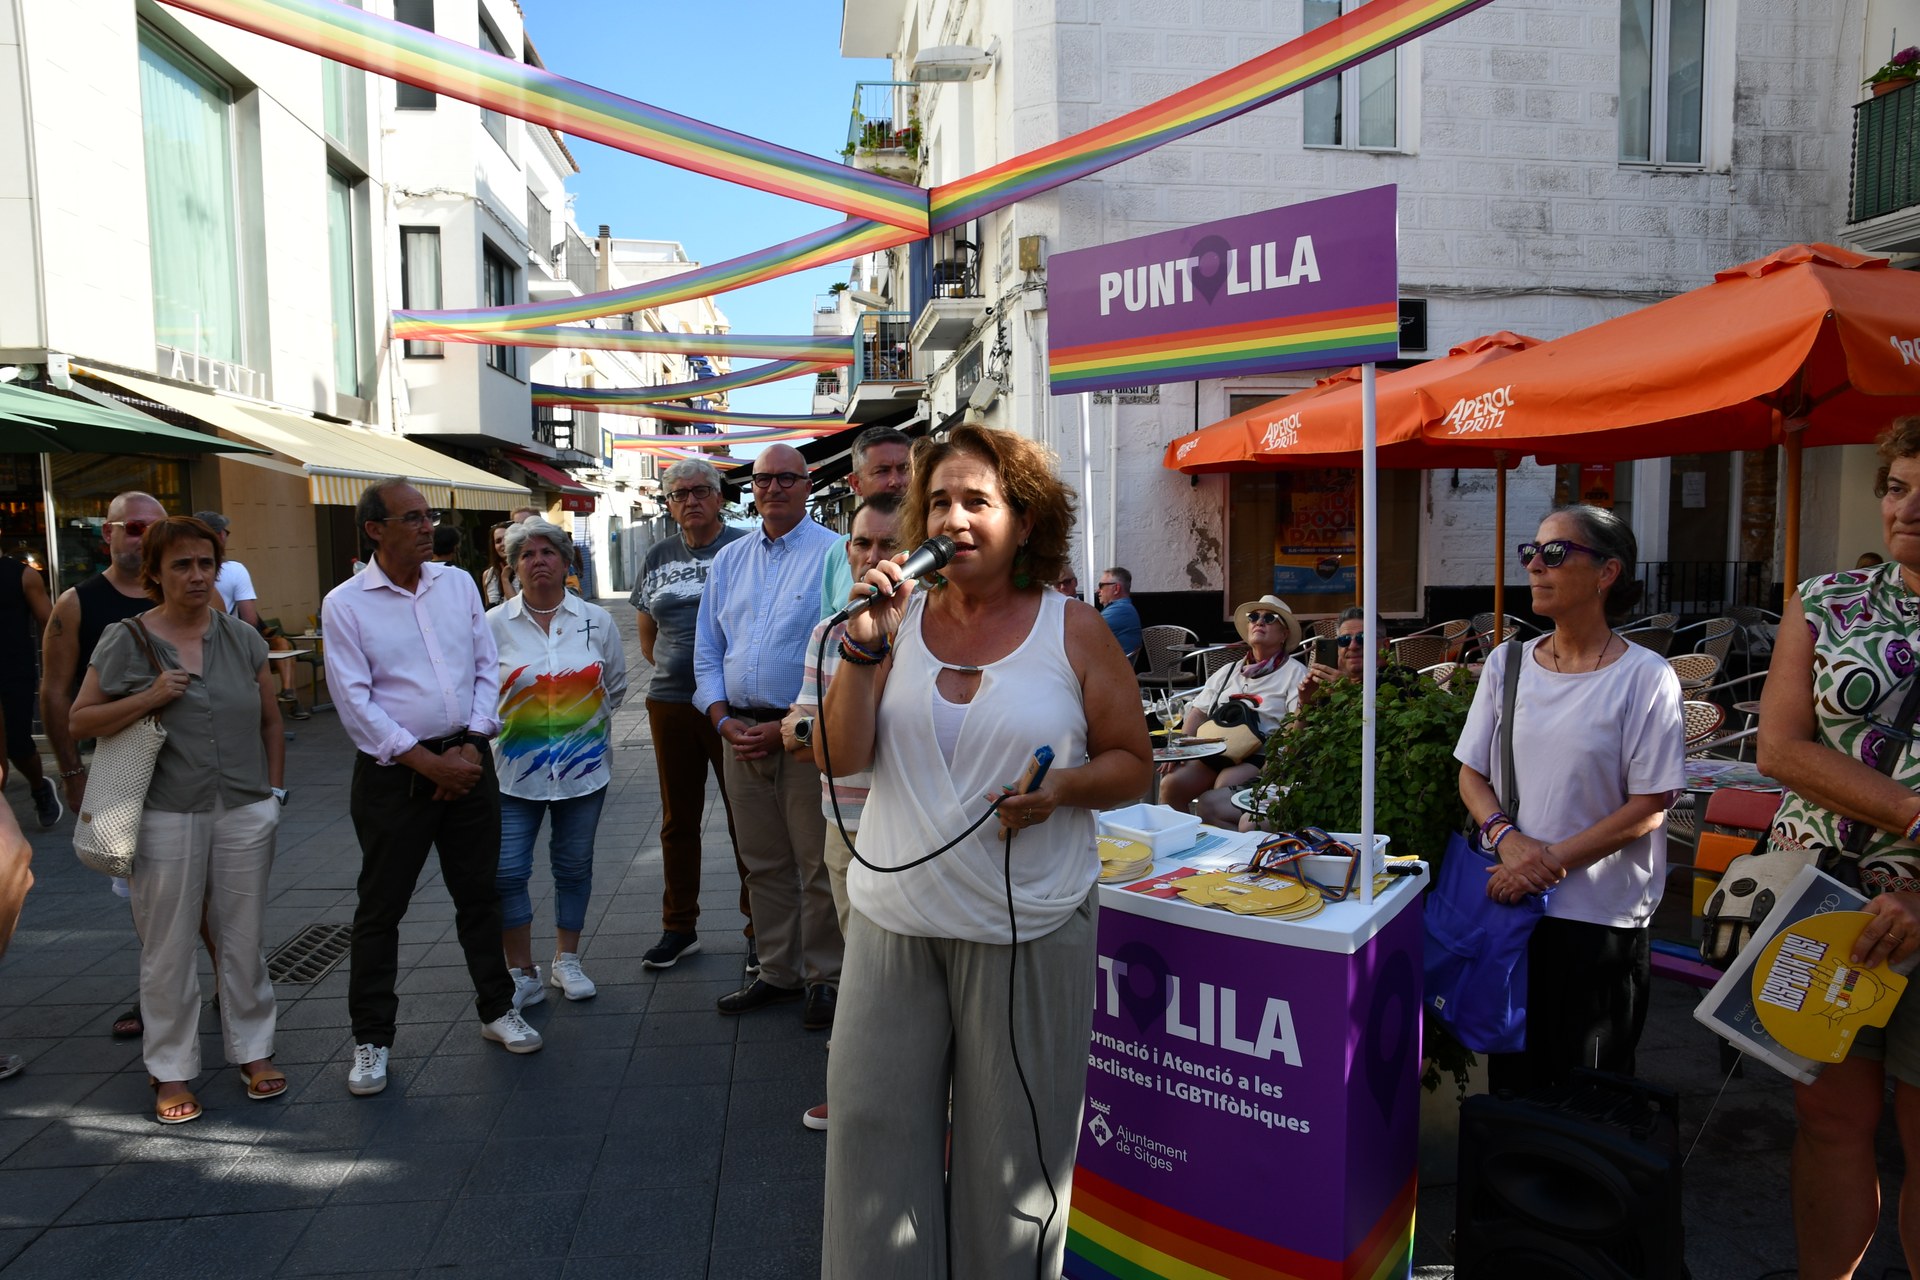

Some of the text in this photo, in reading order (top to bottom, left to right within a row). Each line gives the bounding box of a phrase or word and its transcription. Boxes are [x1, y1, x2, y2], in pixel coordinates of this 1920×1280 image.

[1100, 235, 1321, 316] PUNT LILA
[1260, 412, 1302, 444] APEROL
[1441, 384, 1514, 426] APEROL
[1165, 973, 1303, 1067] LILA
[1153, 1047, 1158, 1065] i
[1162, 1051, 1234, 1086] Atenció
[1237, 1075, 1249, 1091] a
[1254, 1075, 1283, 1099] les
[1156, 1074, 1162, 1092] i
[1166, 1078, 1310, 1134] LGBTIfòbiques
[1115, 1140, 1173, 1172] de Sitges
[1116, 1124, 1188, 1163] Ajuntament
